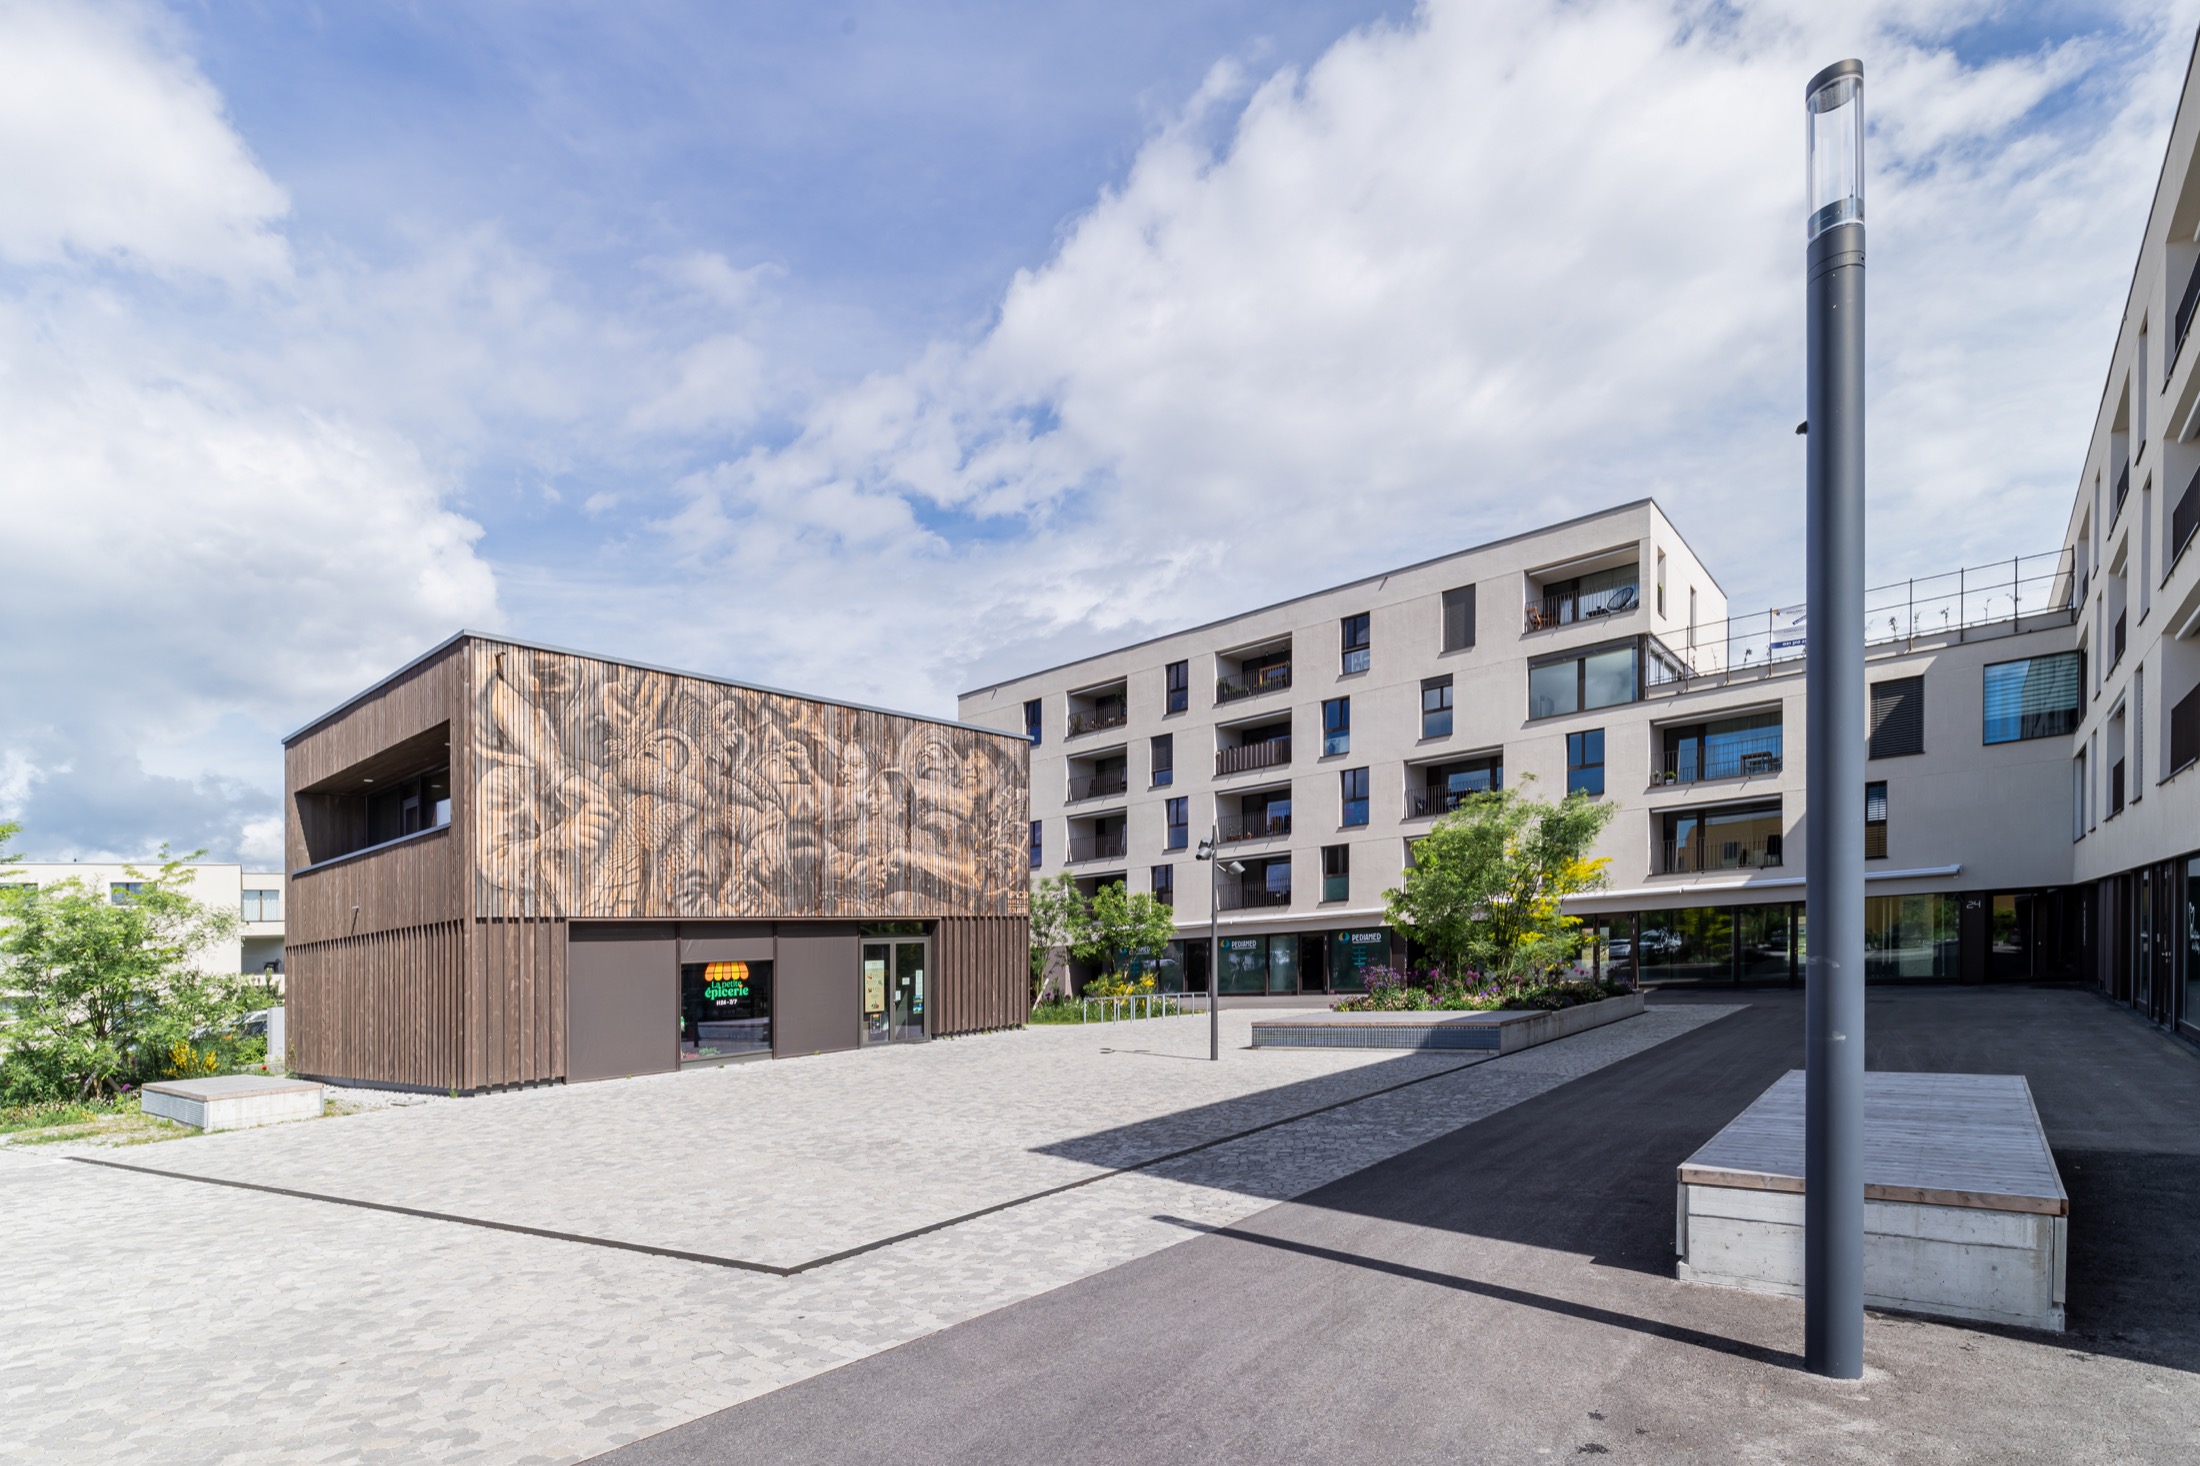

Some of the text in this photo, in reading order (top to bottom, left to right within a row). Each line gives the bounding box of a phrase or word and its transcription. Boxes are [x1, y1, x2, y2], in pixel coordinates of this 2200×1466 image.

[1966, 900, 1981, 909] 24
[1351, 932, 1382, 942] PEDIAMED
[1231, 939, 1257, 948] PEDIAMED
[711, 979, 742, 989] La petite
[704, 984, 749, 1001] épicerie
